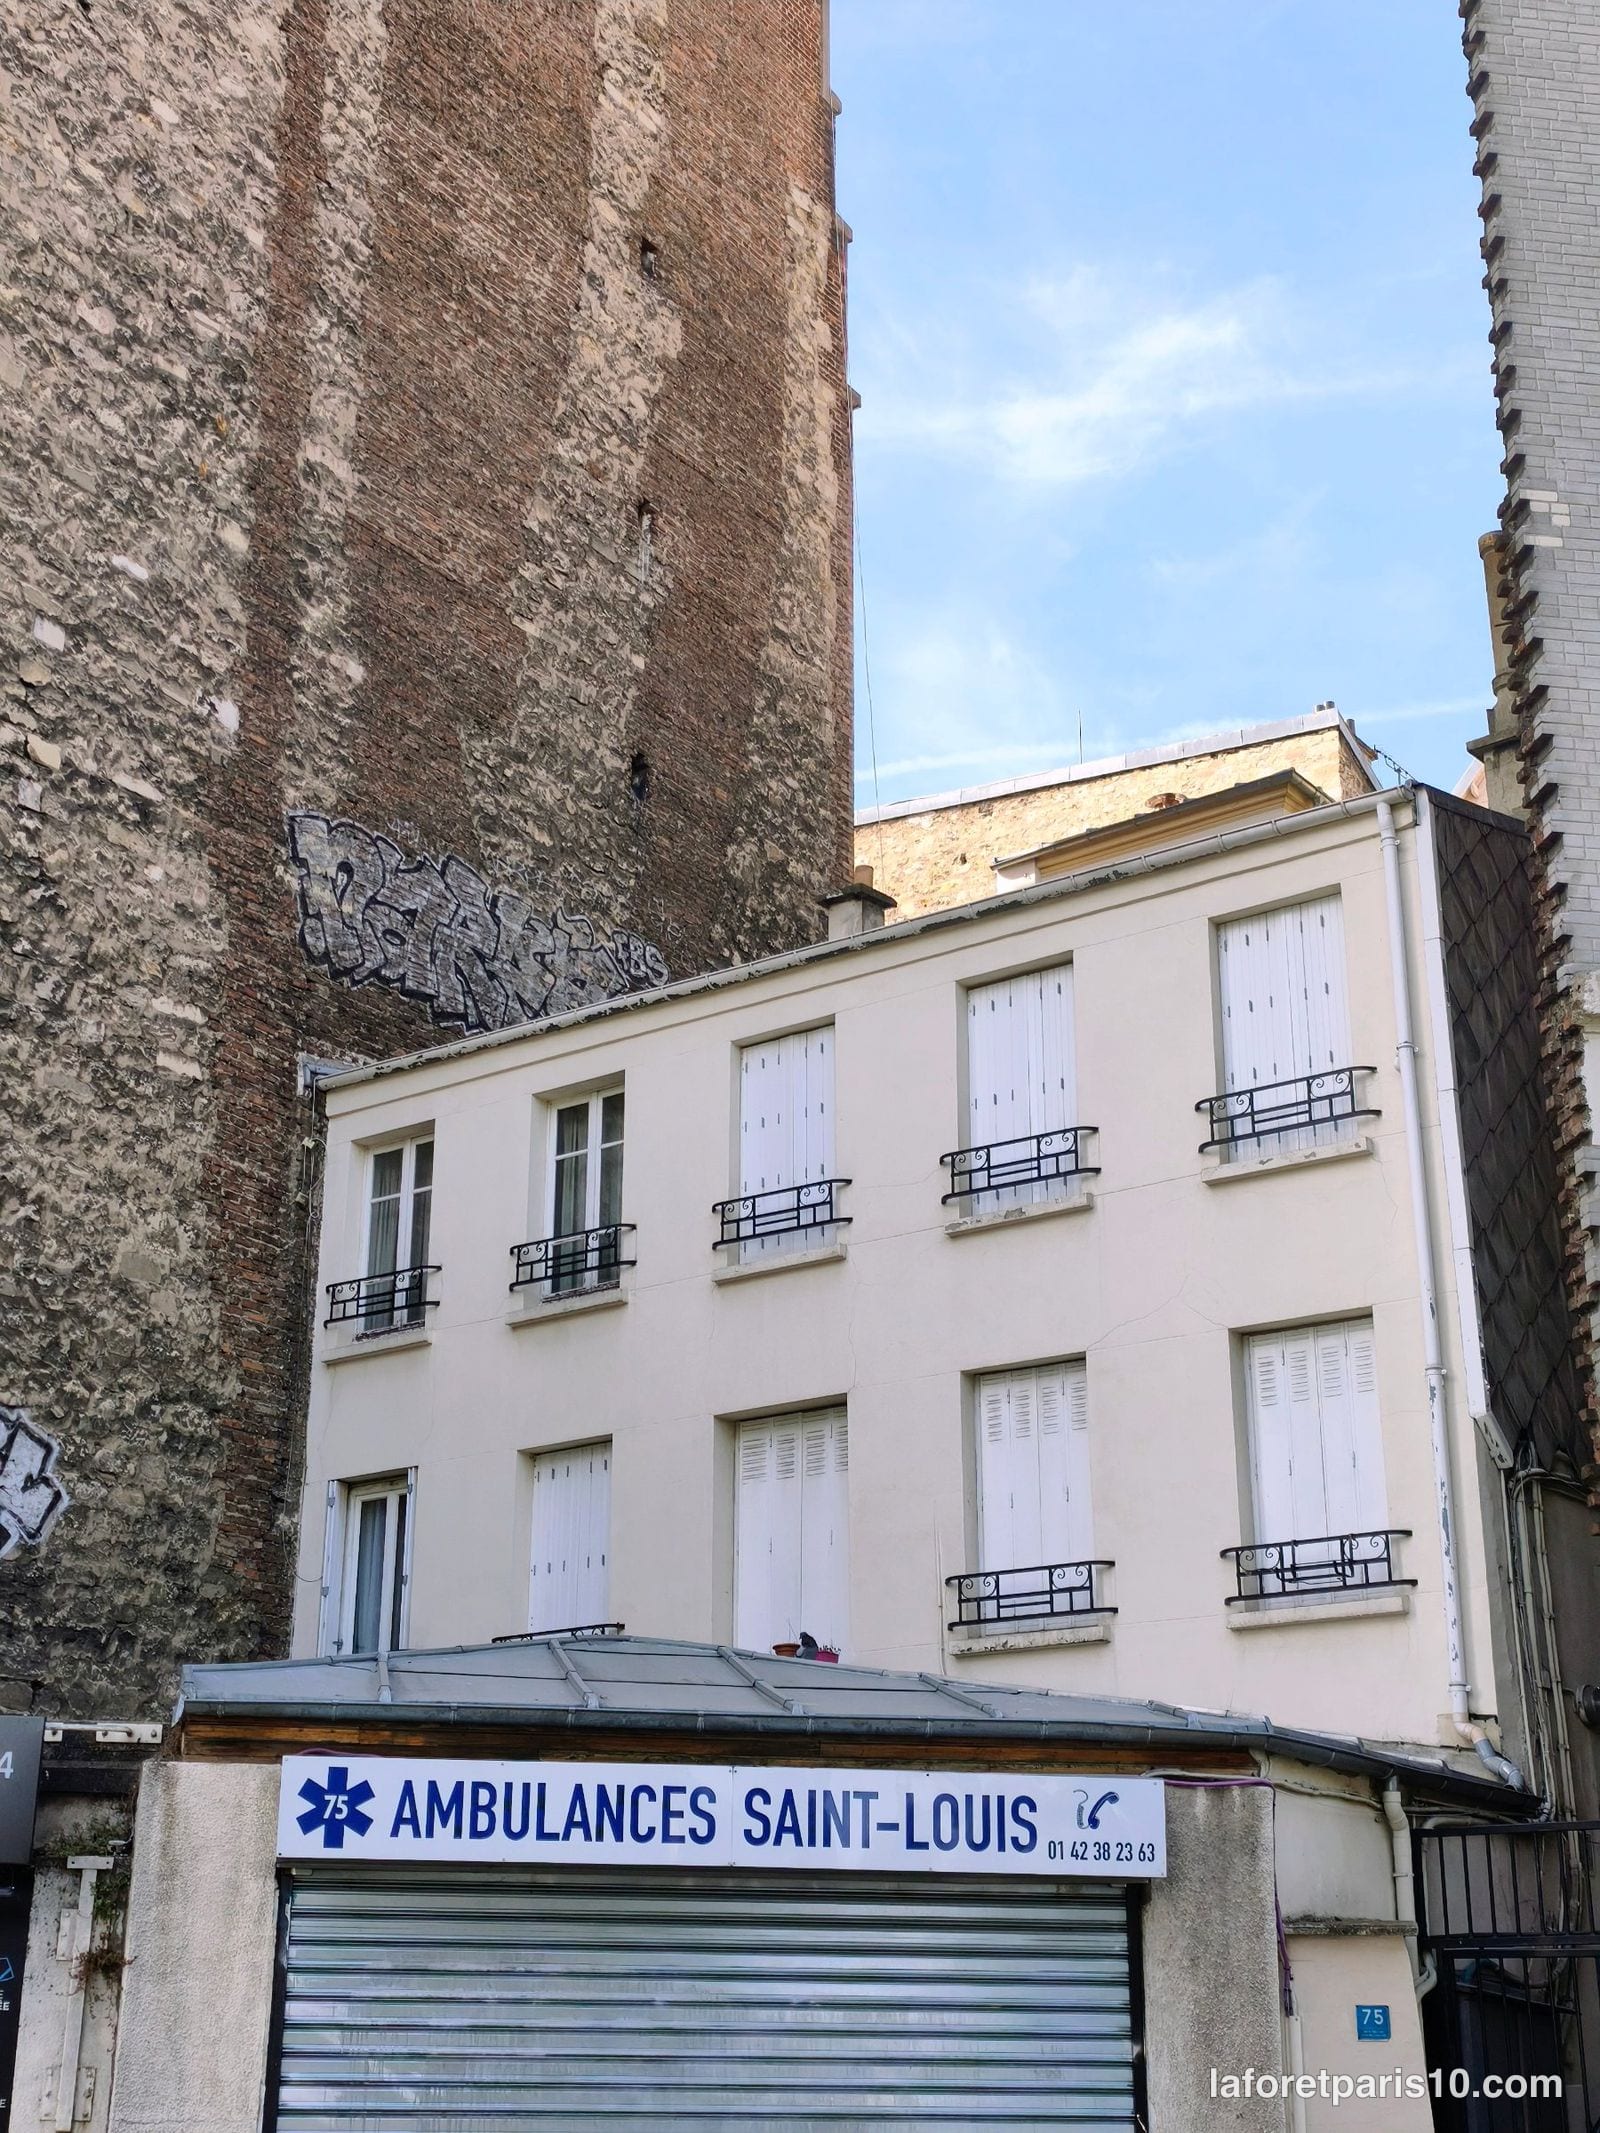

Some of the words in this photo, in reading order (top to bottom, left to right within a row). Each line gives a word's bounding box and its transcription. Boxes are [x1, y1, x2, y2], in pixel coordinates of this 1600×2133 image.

[323, 1795, 348, 1820] 75
[390, 1779, 717, 1845] AMBULANCES
[743, 1787, 1037, 1853] SAINT-LOUIS
[1048, 1840, 1064, 1861] 01
[1070, 1841, 1088, 1861] 42
[1093, 1842, 1111, 1862] 38
[1116, 1842, 1133, 1862] 23
[1138, 1843, 1155, 1863] 63
[1361, 2009, 1384, 2025] 75
